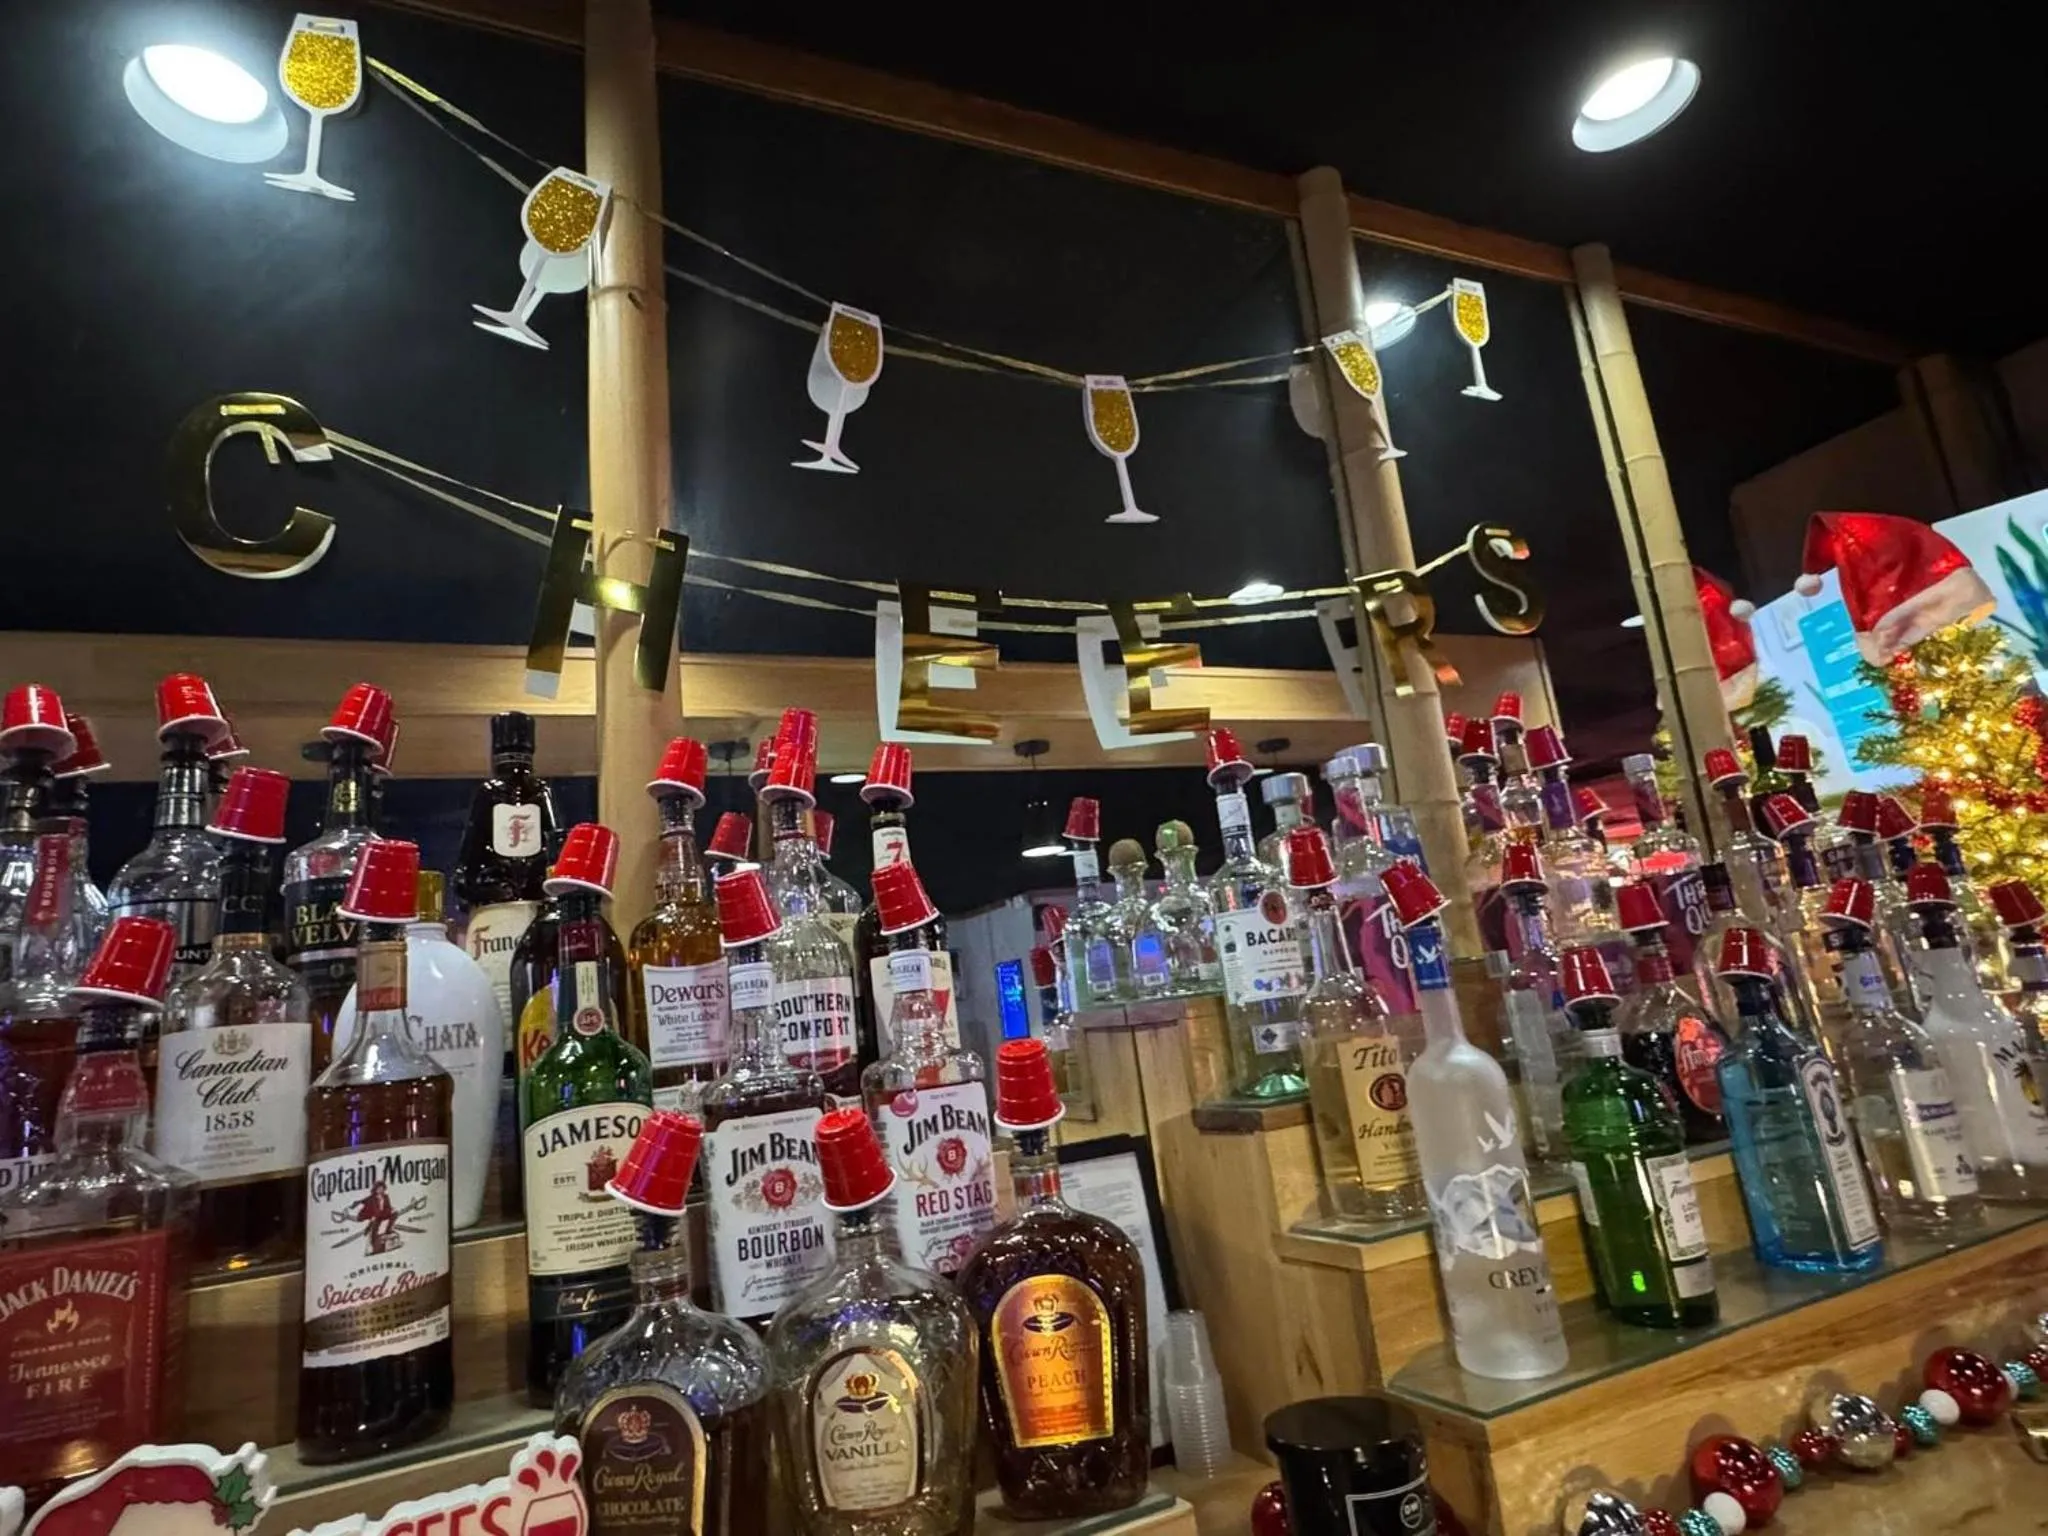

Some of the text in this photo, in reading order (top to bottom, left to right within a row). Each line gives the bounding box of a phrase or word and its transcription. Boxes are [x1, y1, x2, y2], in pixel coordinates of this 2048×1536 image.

[295, 903, 343, 926] BLA
[291, 921, 357, 946] VELV
[1246, 926, 1297, 948] BACAR
[651, 980, 725, 1006] Dewar's
[774, 993, 851, 1020] SOUTHERN
[779, 1016, 850, 1042] COMFORT
[174, 1049, 291, 1081] Canadian
[1353, 1043, 1398, 1071] Tito
[197, 1077, 266, 1109] Club
[204, 1110, 255, 1133] 1858
[903, 1103, 988, 1156] JIM BEAM
[537, 1115, 642, 1158] JAMESO
[725, 1142, 767, 1187] JIM
[310, 1154, 447, 1204] Captain Morgan
[915, 1180, 993, 1218] RED STAG
[558, 1211, 594, 1222] TRIPLE
[565, 1234, 634, 1253] IRISH WHISKE
[737, 1223, 825, 1262] BOURBON
[317, 1270, 439, 1311] Spiced Rum
[1488, 1266, 1538, 1290] GREY
[0, 1266, 143, 1323] JACK DANIEL'S
[9, 1354, 113, 1384] Tennessee
[1026, 1369, 1087, 1390] PEACH
[26, 1374, 93, 1401] FIRE
[830, 1423, 864, 1447] Crown
[825, 1441, 909, 1462] VANILLA
[592, 1461, 686, 1495] Crown Royal
[594, 1497, 687, 1518] CHOCOLATE
